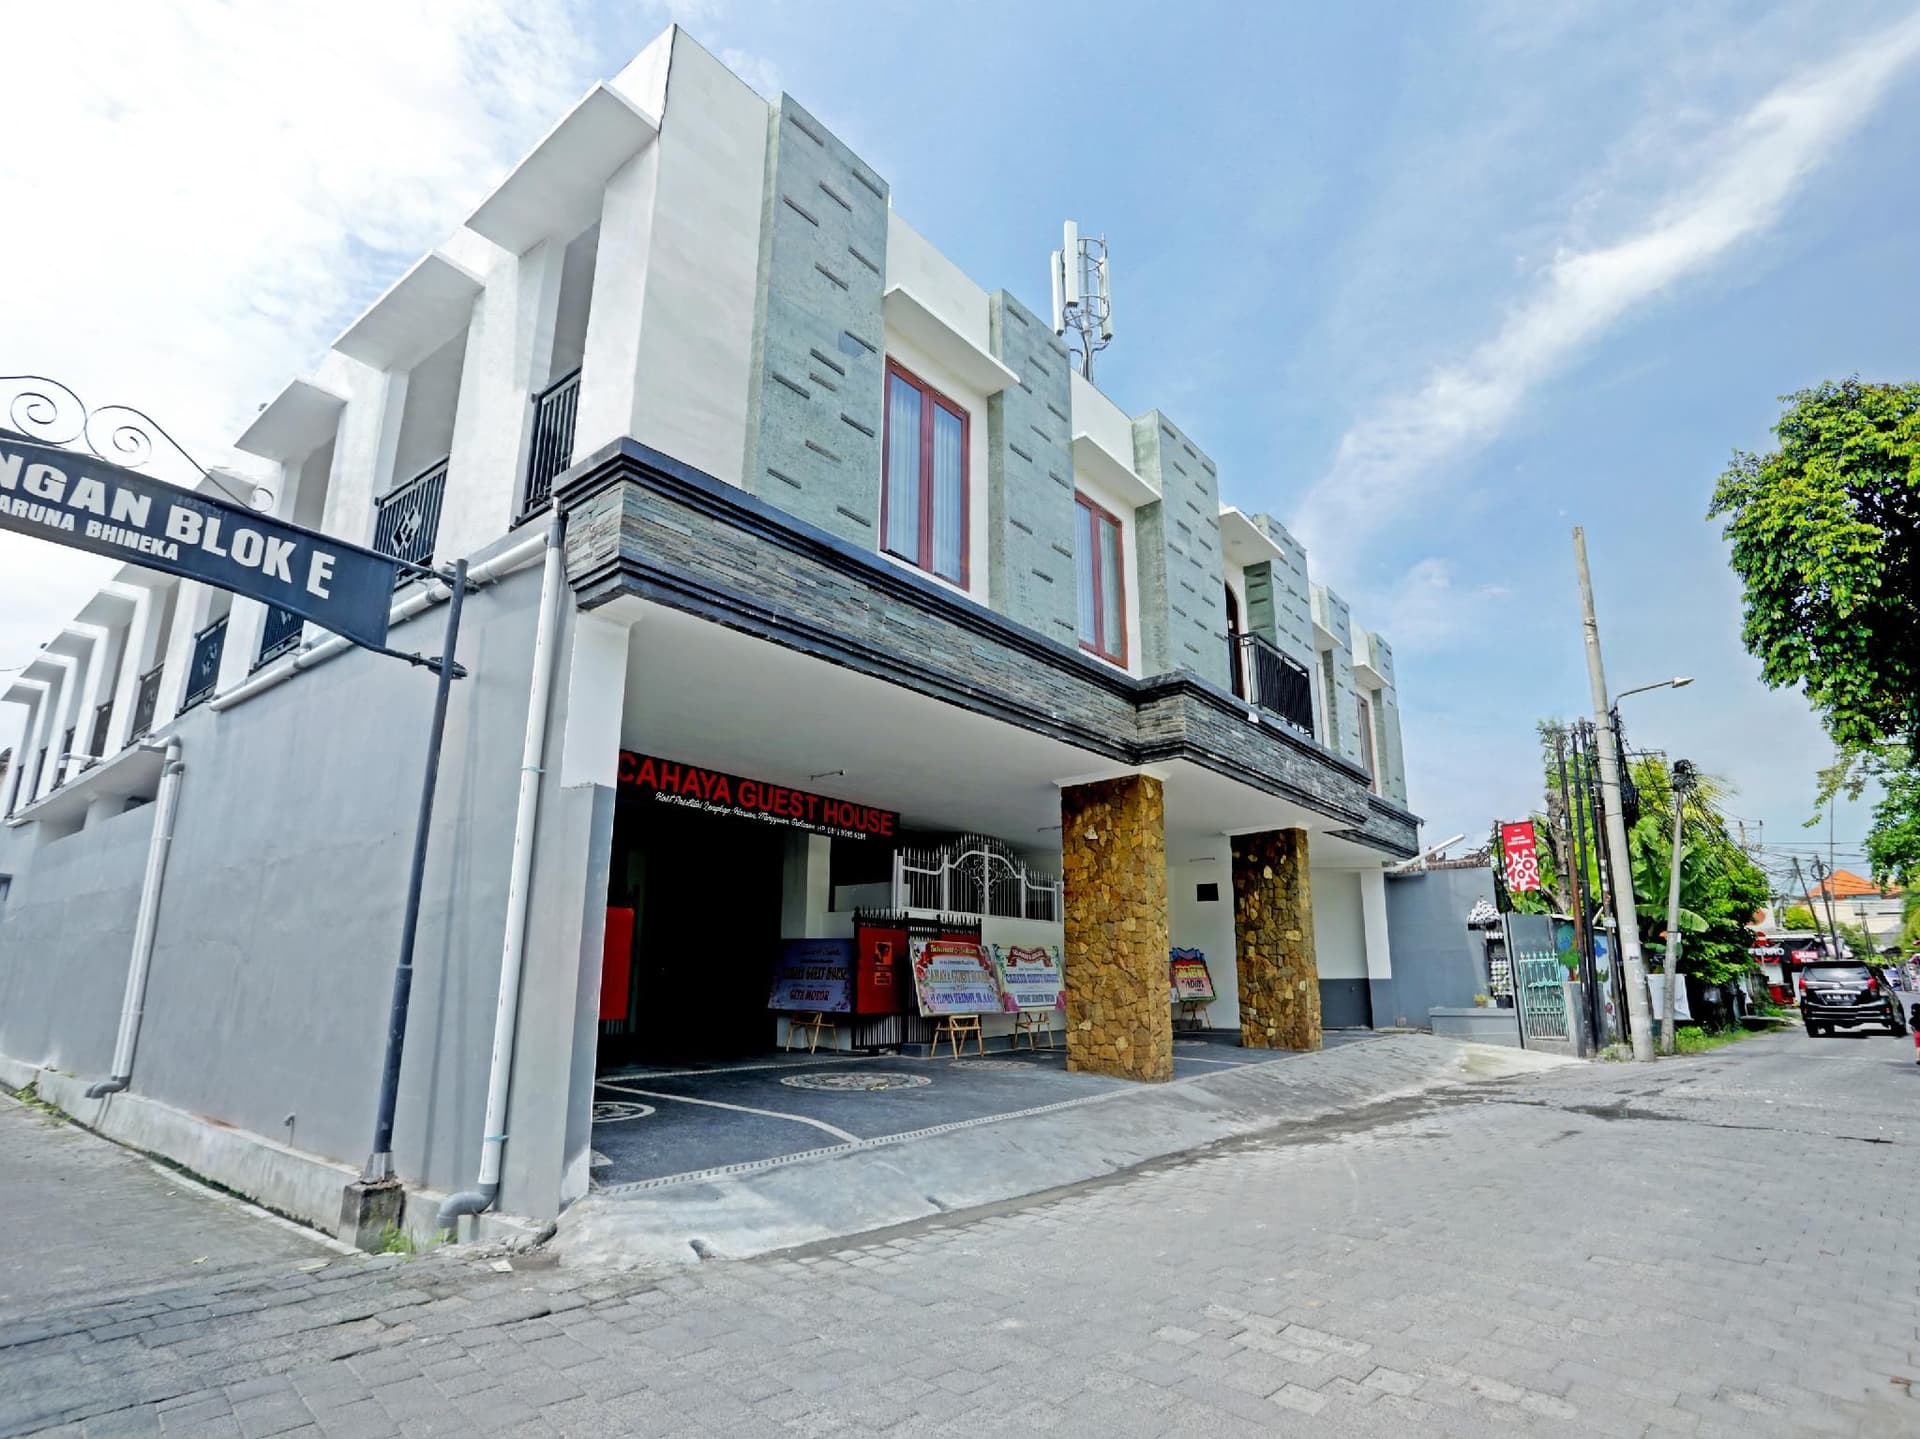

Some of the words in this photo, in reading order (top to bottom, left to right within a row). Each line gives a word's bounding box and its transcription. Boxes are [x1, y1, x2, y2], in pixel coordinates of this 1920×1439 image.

[85, 520, 179, 560] BHINEKA
[166, 504, 297, 584] BLOK
[306, 550, 336, 600] E
[617, 753, 731, 804] CAHAYA
[739, 781, 818, 819] GUEST
[824, 804, 894, 836] HOUSE
